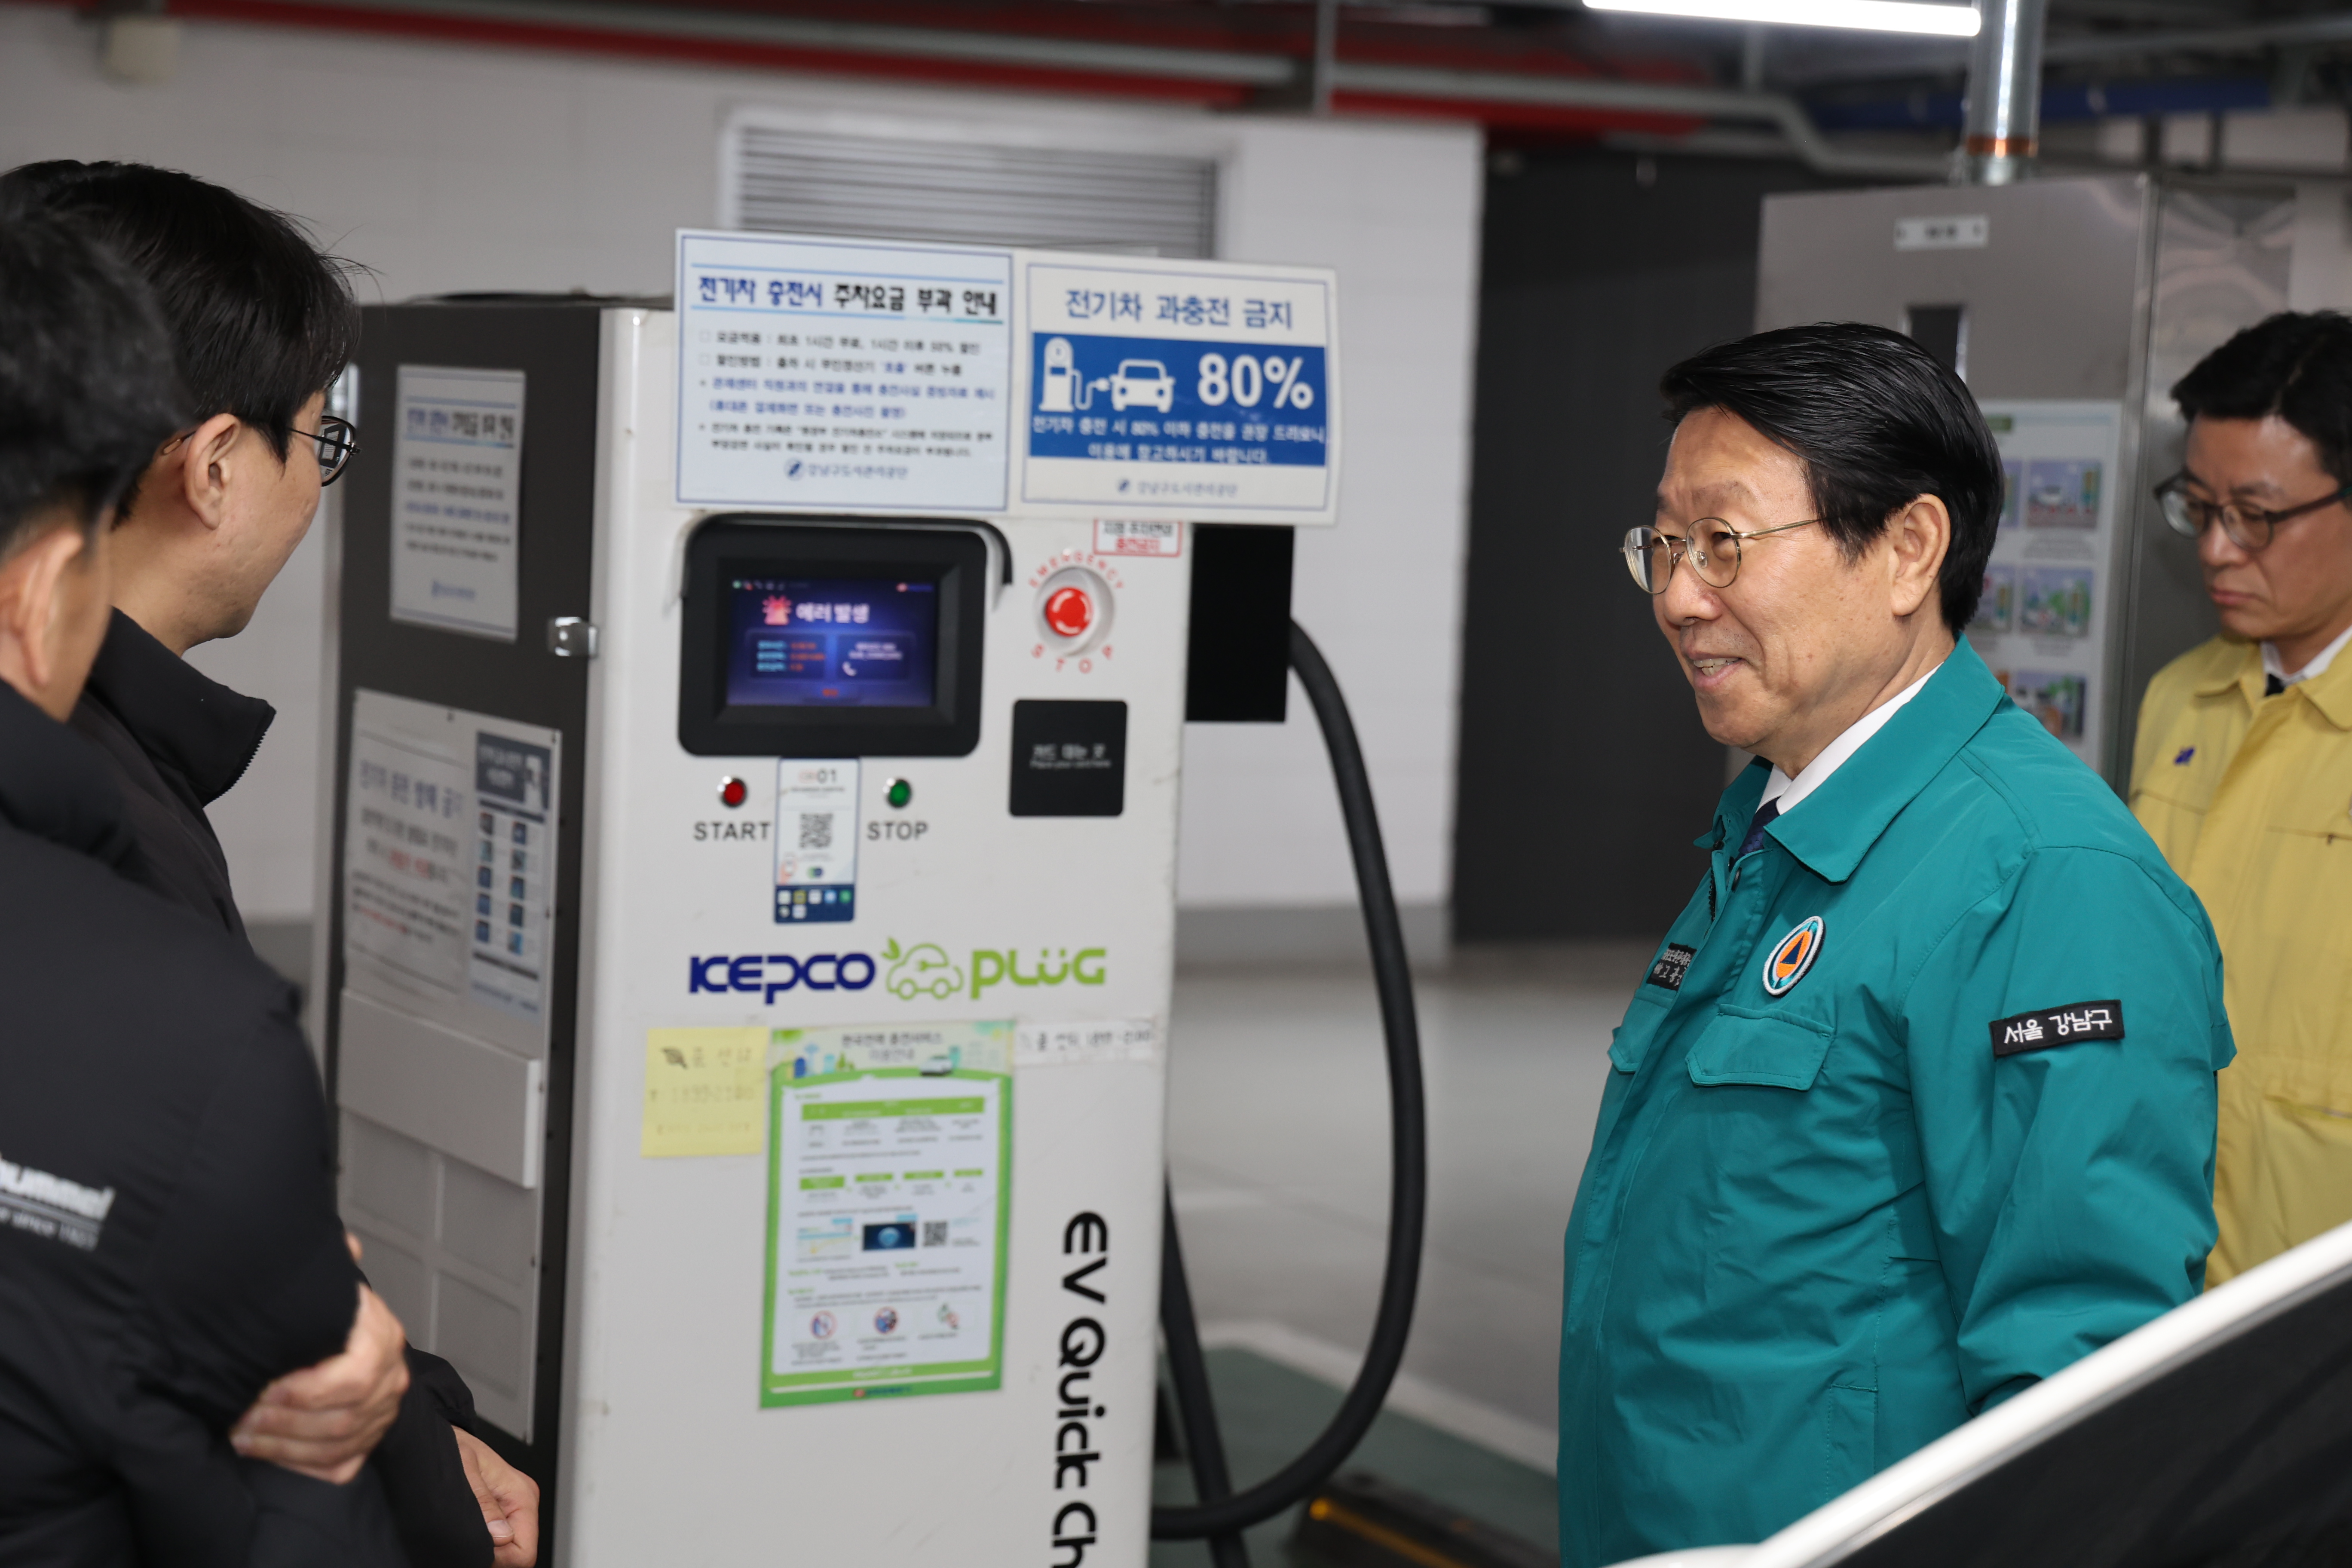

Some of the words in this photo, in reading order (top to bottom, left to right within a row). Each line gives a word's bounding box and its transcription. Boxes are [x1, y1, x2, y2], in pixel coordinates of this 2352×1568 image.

[699, 277, 756, 302] 전기차
[767, 281, 822, 306] 충전시
[834, 284, 905, 311] 주차요금
[919, 289, 952, 311] 부과
[962, 291, 997, 315] 안내
[1067, 290, 1142, 320] 전기차
[1158, 296, 1229, 326] 과충전
[1244, 300, 1291, 329] 금지
[1198, 353, 1313, 408] 80%
[795, 603, 831, 623] 에러
[1032, 644, 1113, 674] STOP
[695, 822, 770, 841] START
[868, 821, 928, 840] STOP
[689, 953, 876, 1004] KEPCO
[2005, 1017, 2043, 1043] 서울
[2049, 1009, 2112, 1035] 강남구
[1063, 1212, 1108, 1304] EV
[1056, 1317, 1106, 1489] Quick
